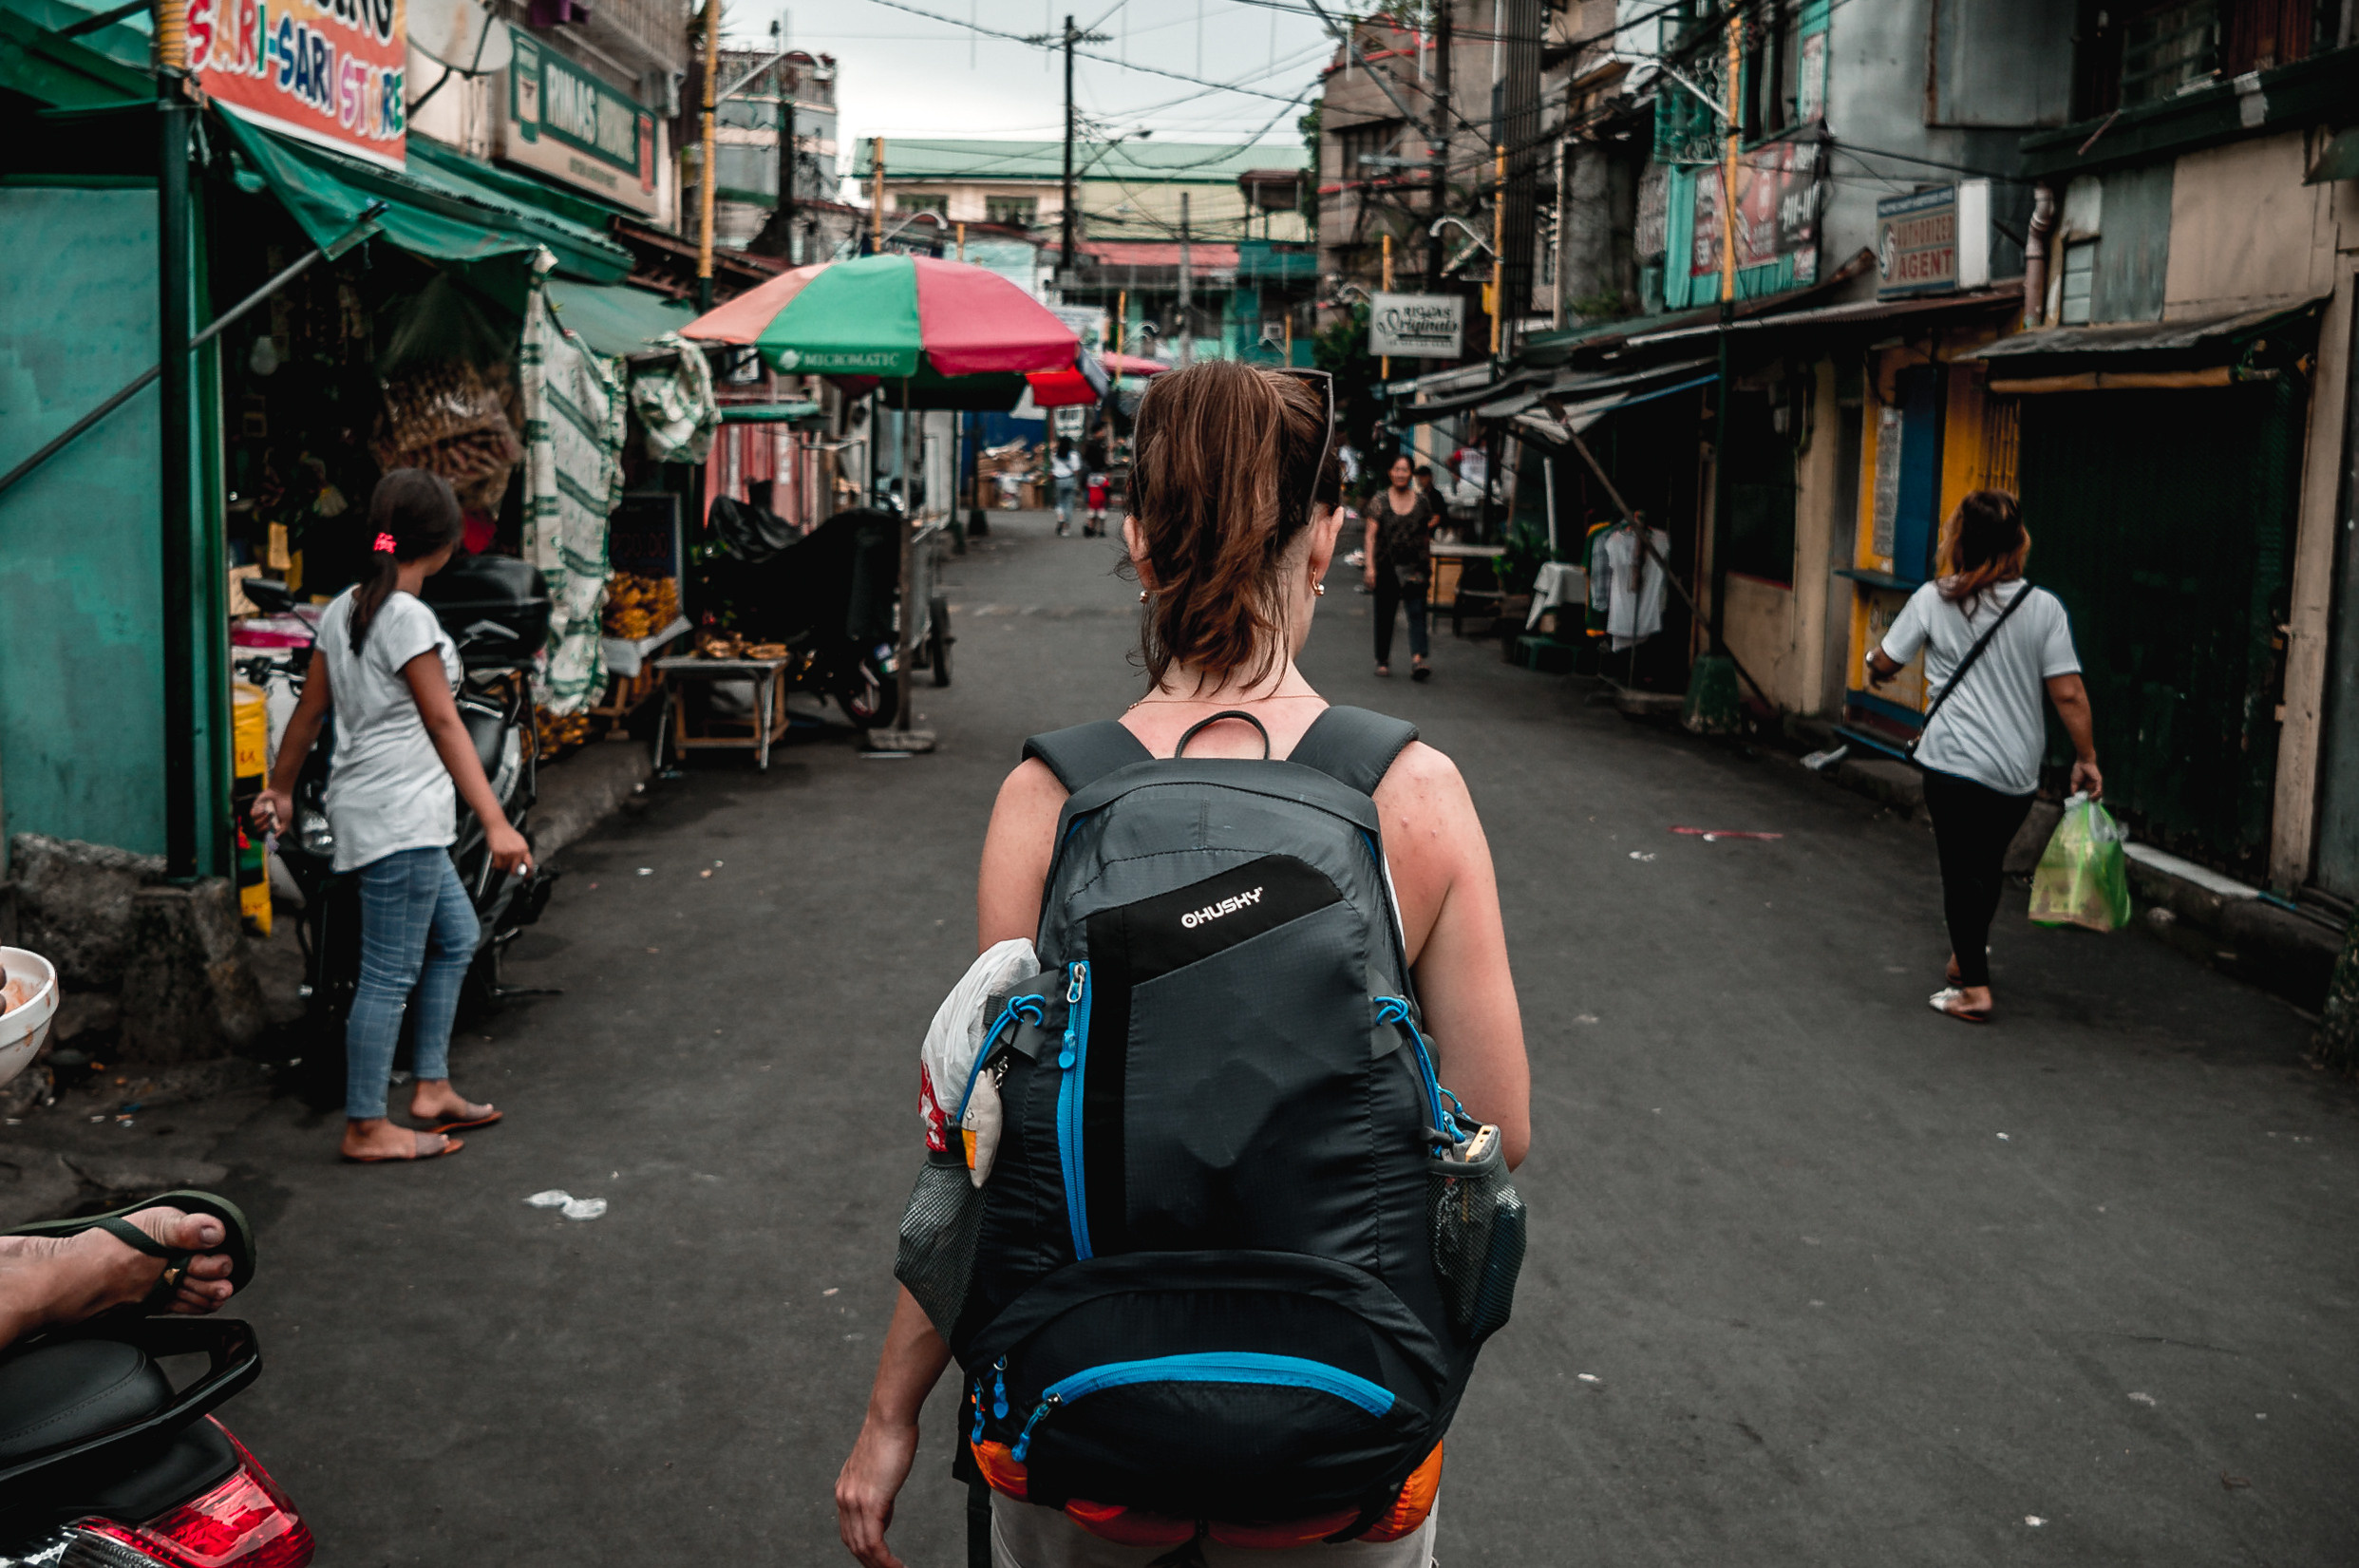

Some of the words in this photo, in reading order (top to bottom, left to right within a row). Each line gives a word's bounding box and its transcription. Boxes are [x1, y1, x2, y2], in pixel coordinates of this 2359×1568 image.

[186, 0, 334, 117] SARI-SARI
[339, 52, 405, 140] STORE
[1899, 248, 1954, 280] AGENT
[803, 352, 900, 367] MICROMATIC
